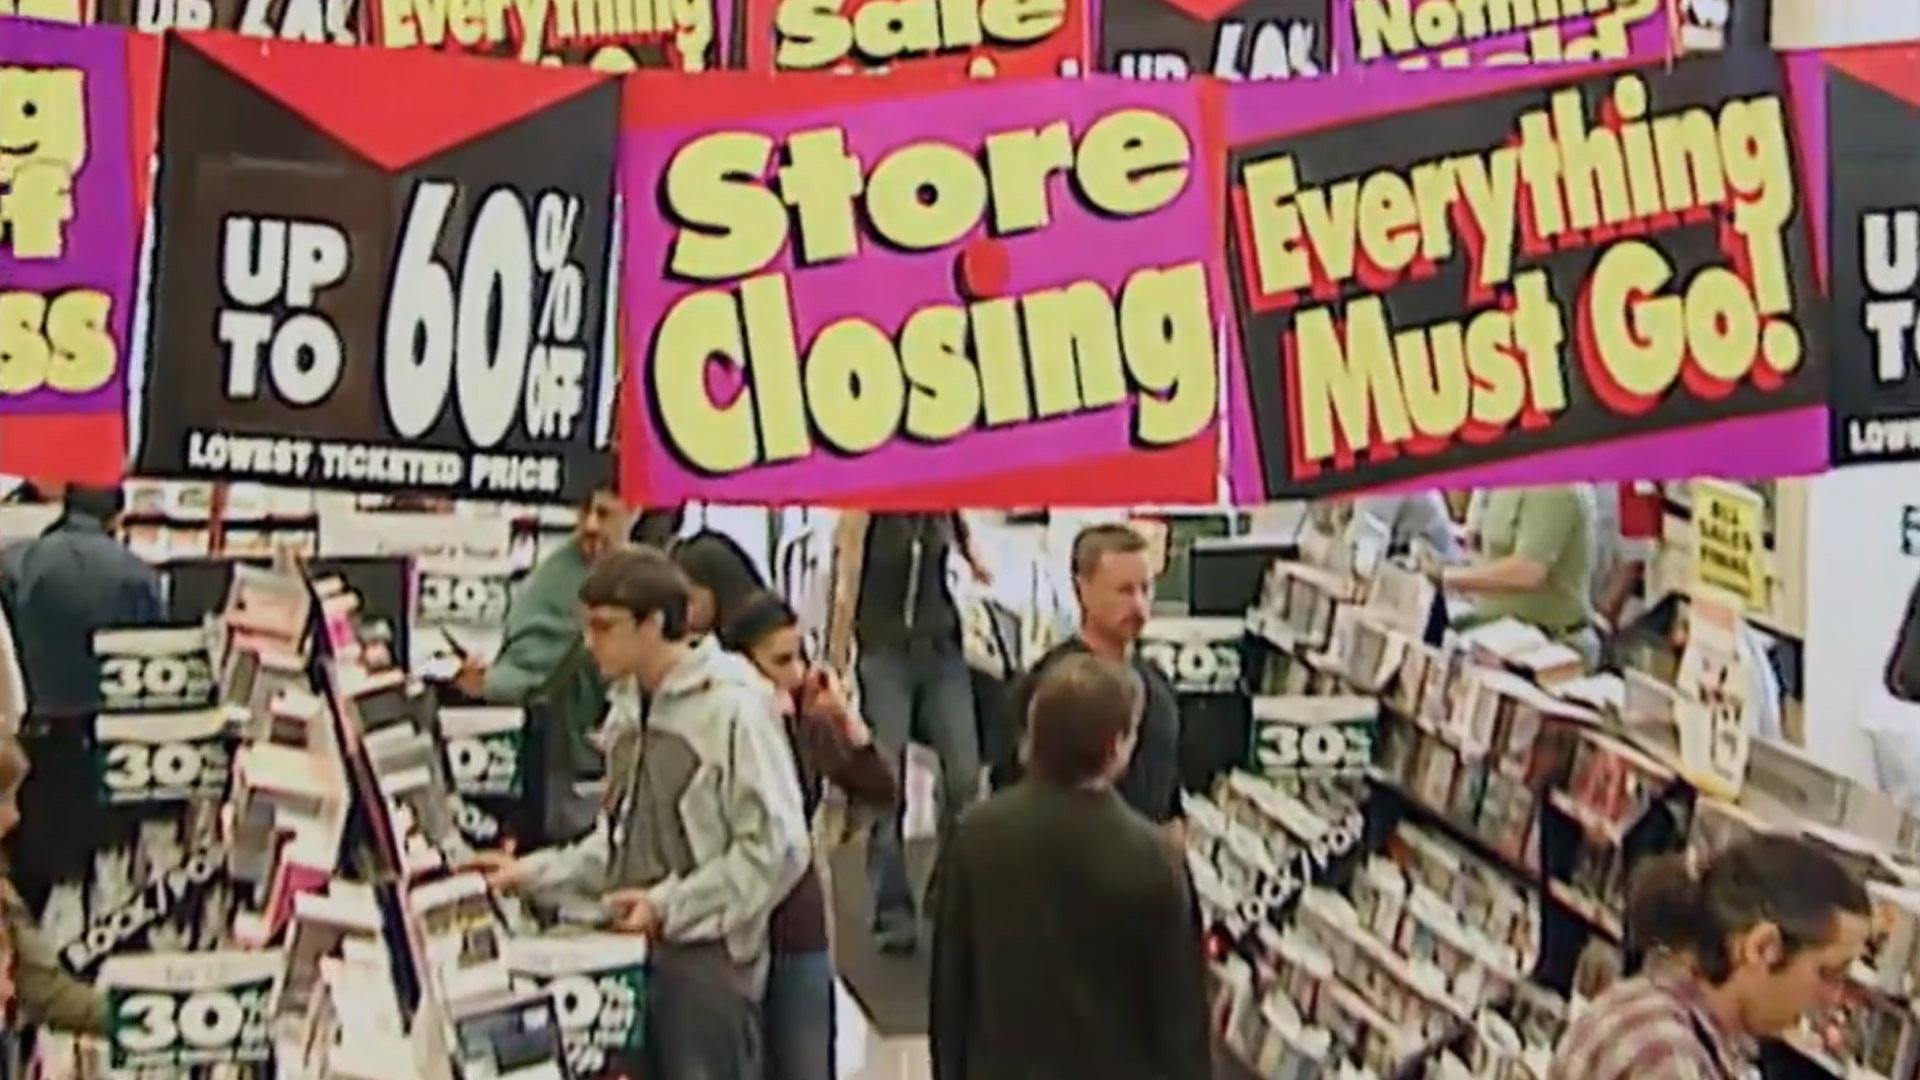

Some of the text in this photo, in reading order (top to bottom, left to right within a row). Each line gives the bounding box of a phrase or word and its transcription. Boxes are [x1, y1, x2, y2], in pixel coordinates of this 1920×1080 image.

[776, 0, 1066, 68] Sale
[0, 160, 75, 259] f
[667, 108, 1190, 279] Store
[1240, 75, 1796, 297] Everything
[222, 218, 349, 306] UP
[219, 312, 343, 405] TO
[383, 180, 583, 448] 60%
[653, 243, 1218, 472] Closing
[1296, 211, 1801, 460] Must Go!
[1865, 299, 1920, 383] T
[524, 343, 588, 440] OFF
[188, 431, 561, 491] LOWEST TICKETED PRICE
